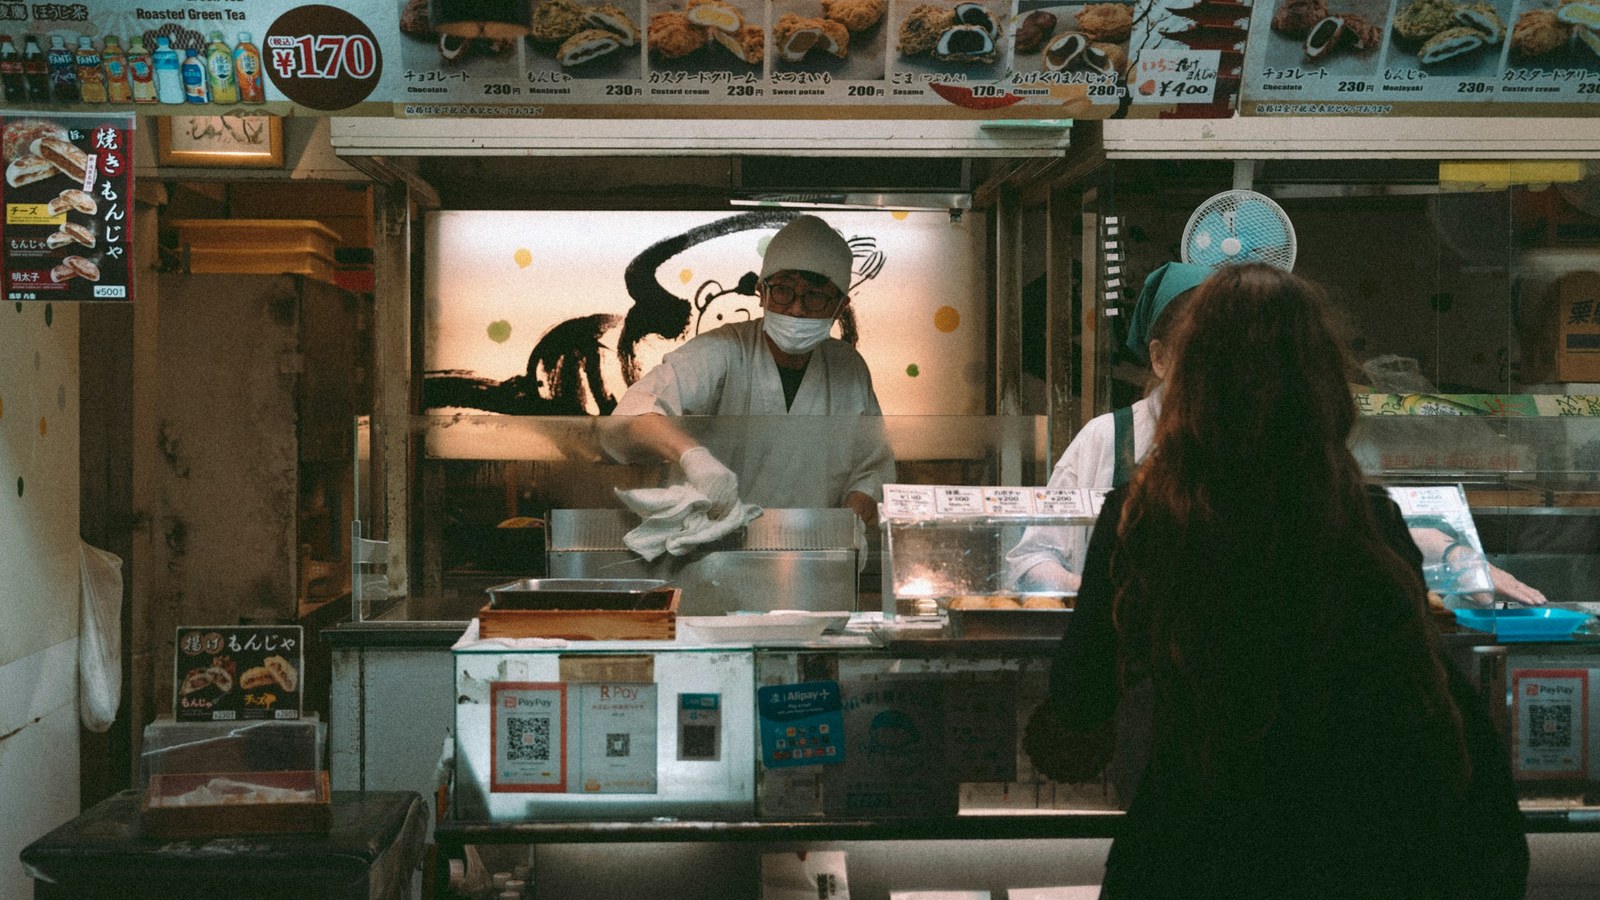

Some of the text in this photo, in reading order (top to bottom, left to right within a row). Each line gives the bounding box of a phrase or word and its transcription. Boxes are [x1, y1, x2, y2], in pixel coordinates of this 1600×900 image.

[33, 3, 88, 20] ほうじ茶
[136, 8, 246, 20] Roasted Green Tea
[276, 36, 375, 77] ¥170
[404, 70, 470, 82] チョコレート
[528, 71, 572, 83] もんじゃ
[648, 72, 757, 84] カスタードクリーム
[770, 72, 832, 85] さつまいも
[892, 73, 914, 85] ごま
[1262, 68, 1328, 80] チョコレート
[1384, 69, 1428, 81] もんじゃ
[1502, 69, 1600, 82] カスタードクリー
[483, 83, 521, 95] 230円
[605, 85, 642, 96] 230円
[727, 85, 764, 96] 230円
[848, 85, 885, 97] 200円
[972, 85, 1005, 97] 170円
[1086, 84, 1126, 97] 280円
[1159, 80, 1208, 96] ¥400
[1337, 81, 1375, 93] 230円
[1457, 82, 1494, 94] 230円
[96, 127, 125, 260] 焼きもんじゃ
[10, 206, 38, 216] チーズ
[10, 240, 46, 250] もんじゃ
[11, 272, 40, 283] 明太子
[613, 685, 639, 701] Pay
[1540, 685, 1574, 695] PayPay
[518, 698, 552, 709] PayPay
